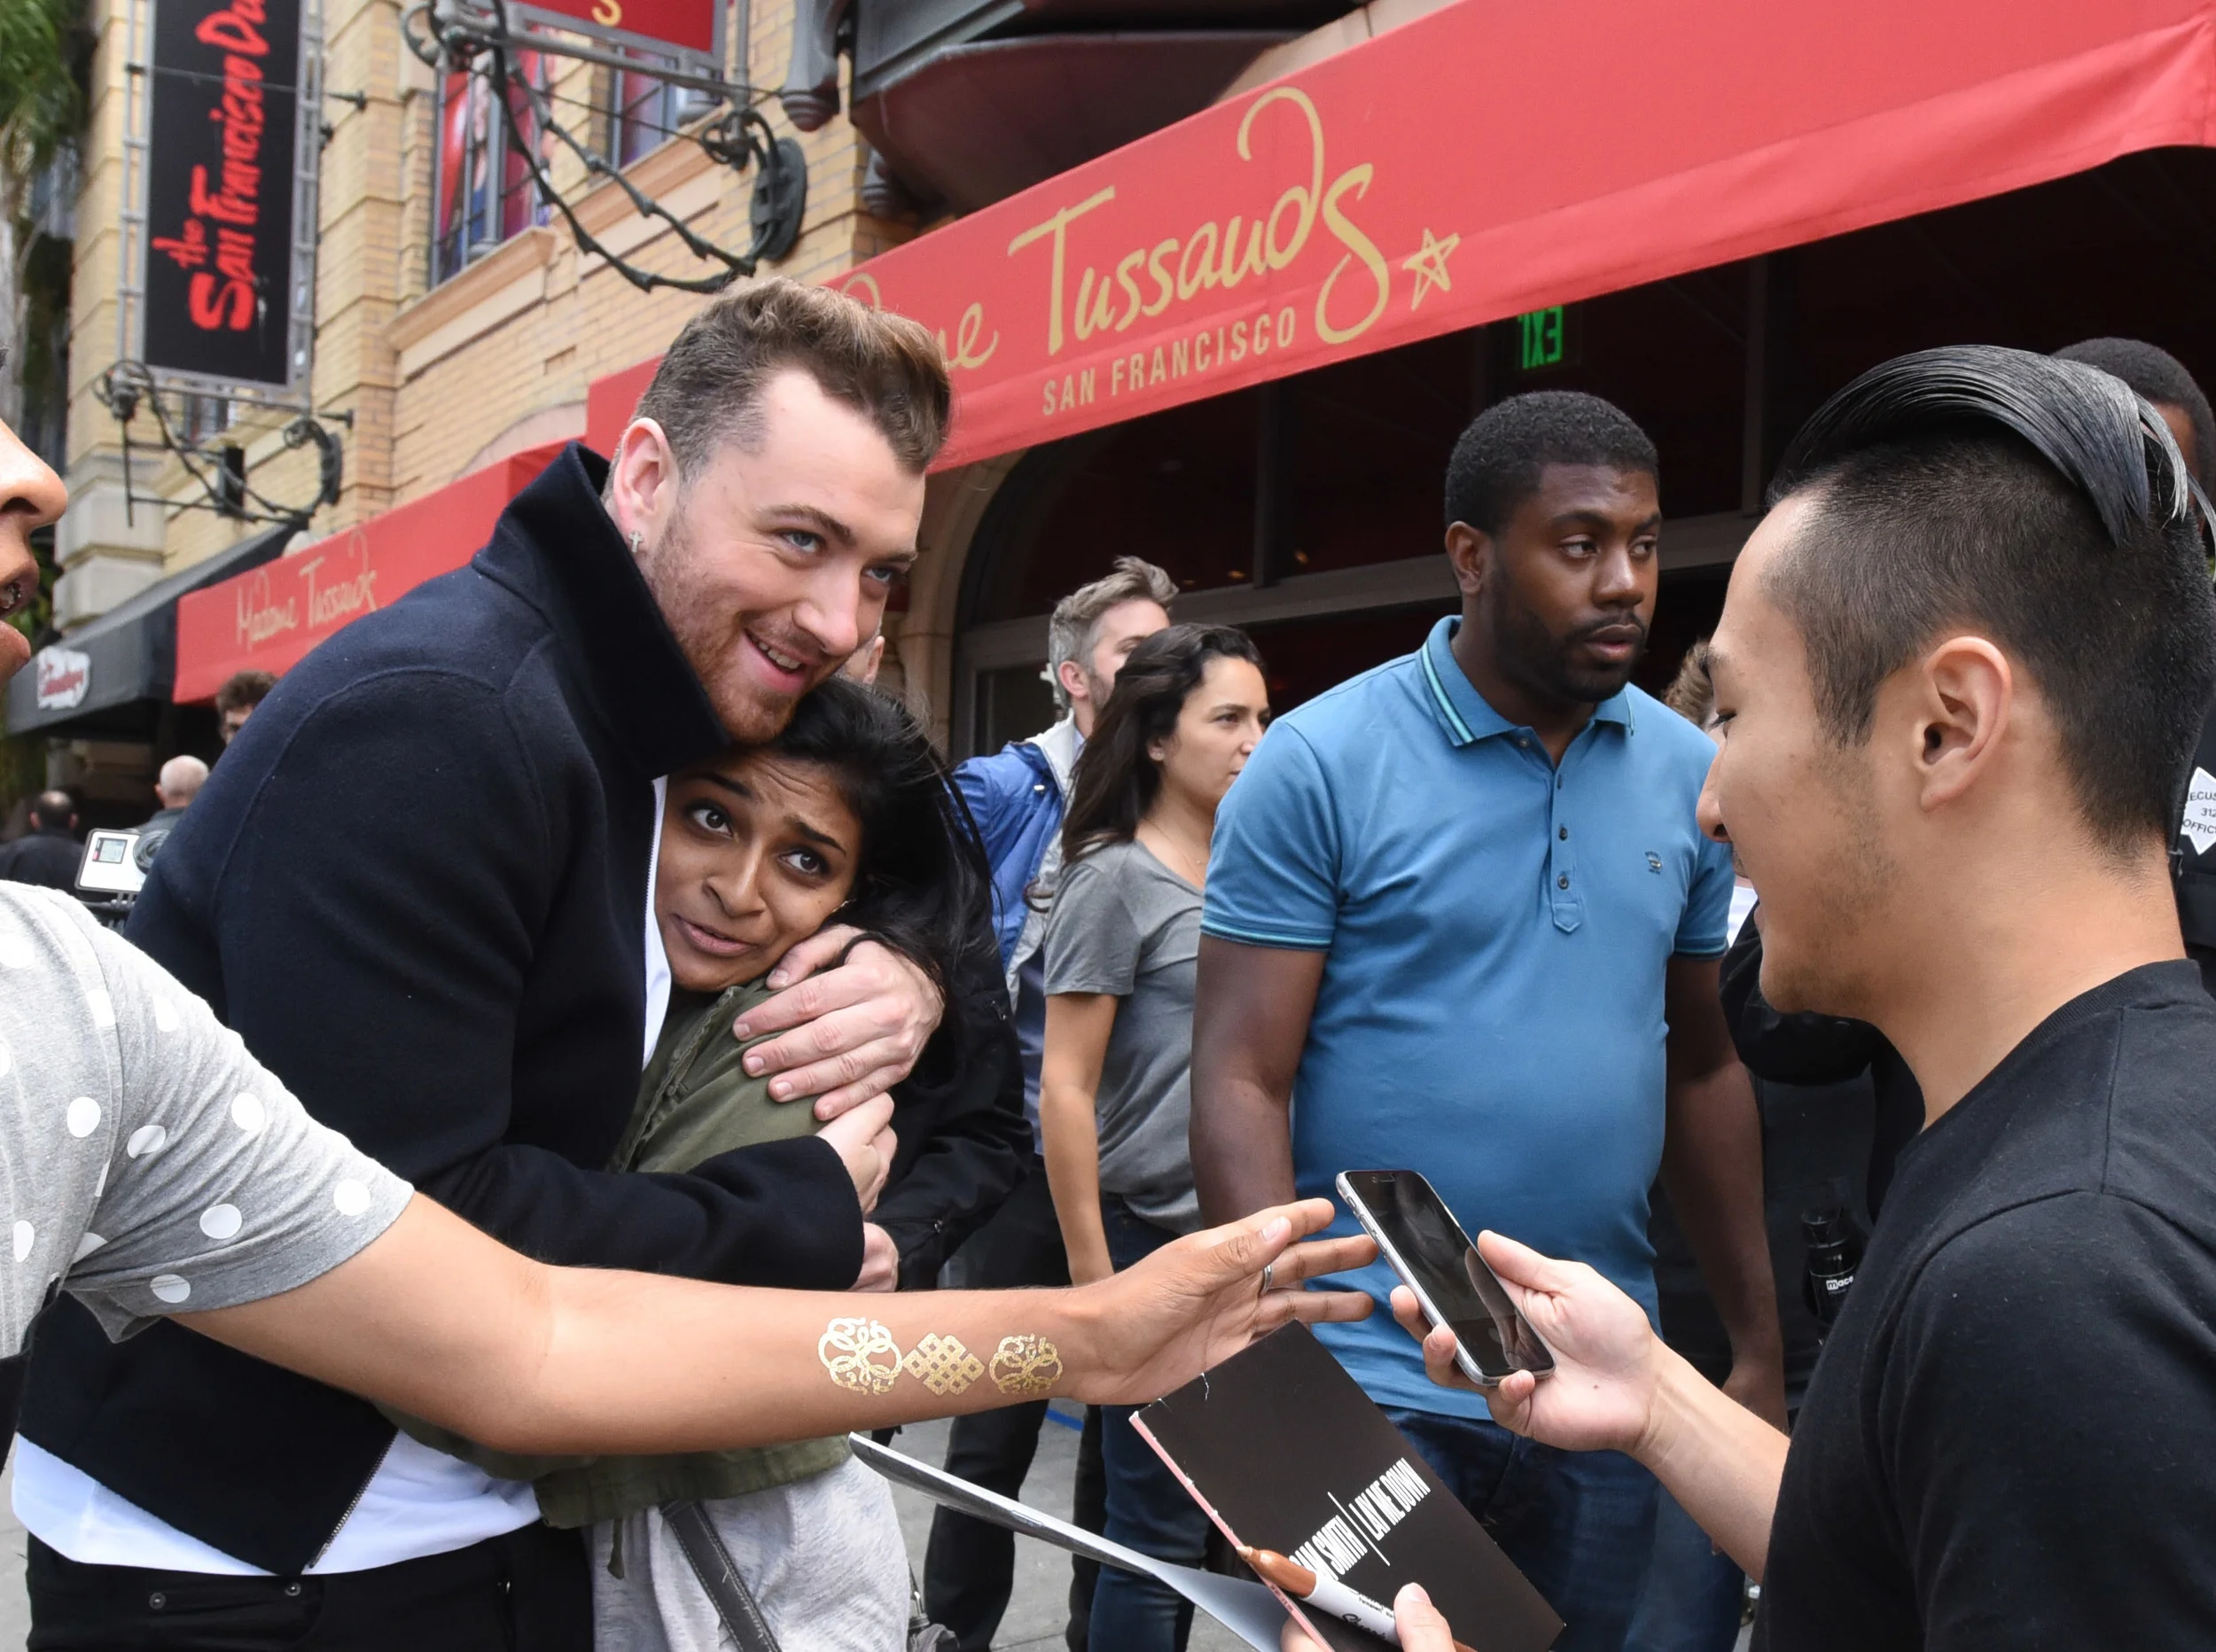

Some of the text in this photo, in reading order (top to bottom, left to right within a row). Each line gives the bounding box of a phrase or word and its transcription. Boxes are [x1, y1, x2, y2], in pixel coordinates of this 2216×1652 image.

[189, 54, 265, 225] Francisco
[152, 217, 210, 269] the
[1007, 86, 1392, 356] Tussauds
[189, 228, 256, 331] San
[1042, 306, 1296, 416] SAN FRANCISCO
[2182, 818, 2216, 834] OFFIC
[1365, 1479, 1407, 1526] ME
[1379, 1457, 1432, 1513] DOWN
[1312, 1514, 1369, 1576] SMITH
[1347, 1492, 1392, 1541] LAY
